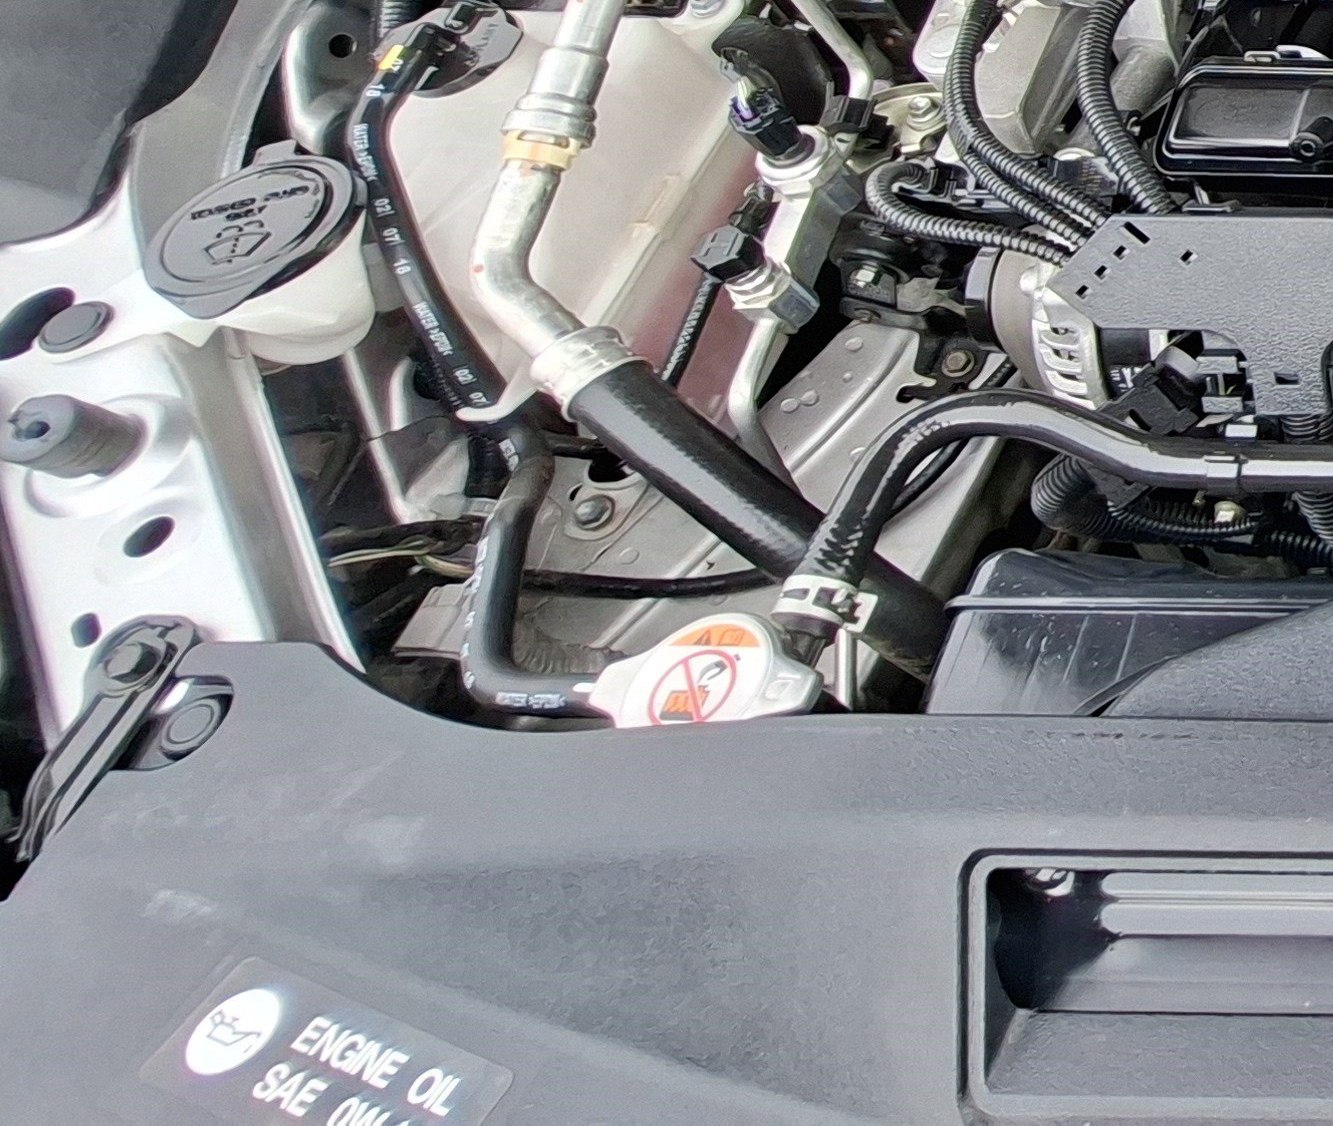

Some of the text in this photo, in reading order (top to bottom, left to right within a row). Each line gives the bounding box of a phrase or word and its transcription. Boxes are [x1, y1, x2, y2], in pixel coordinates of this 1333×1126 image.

[252, 1063, 331, 1117] SAE
[290, 1016, 462, 1117] ENGINE OIL
